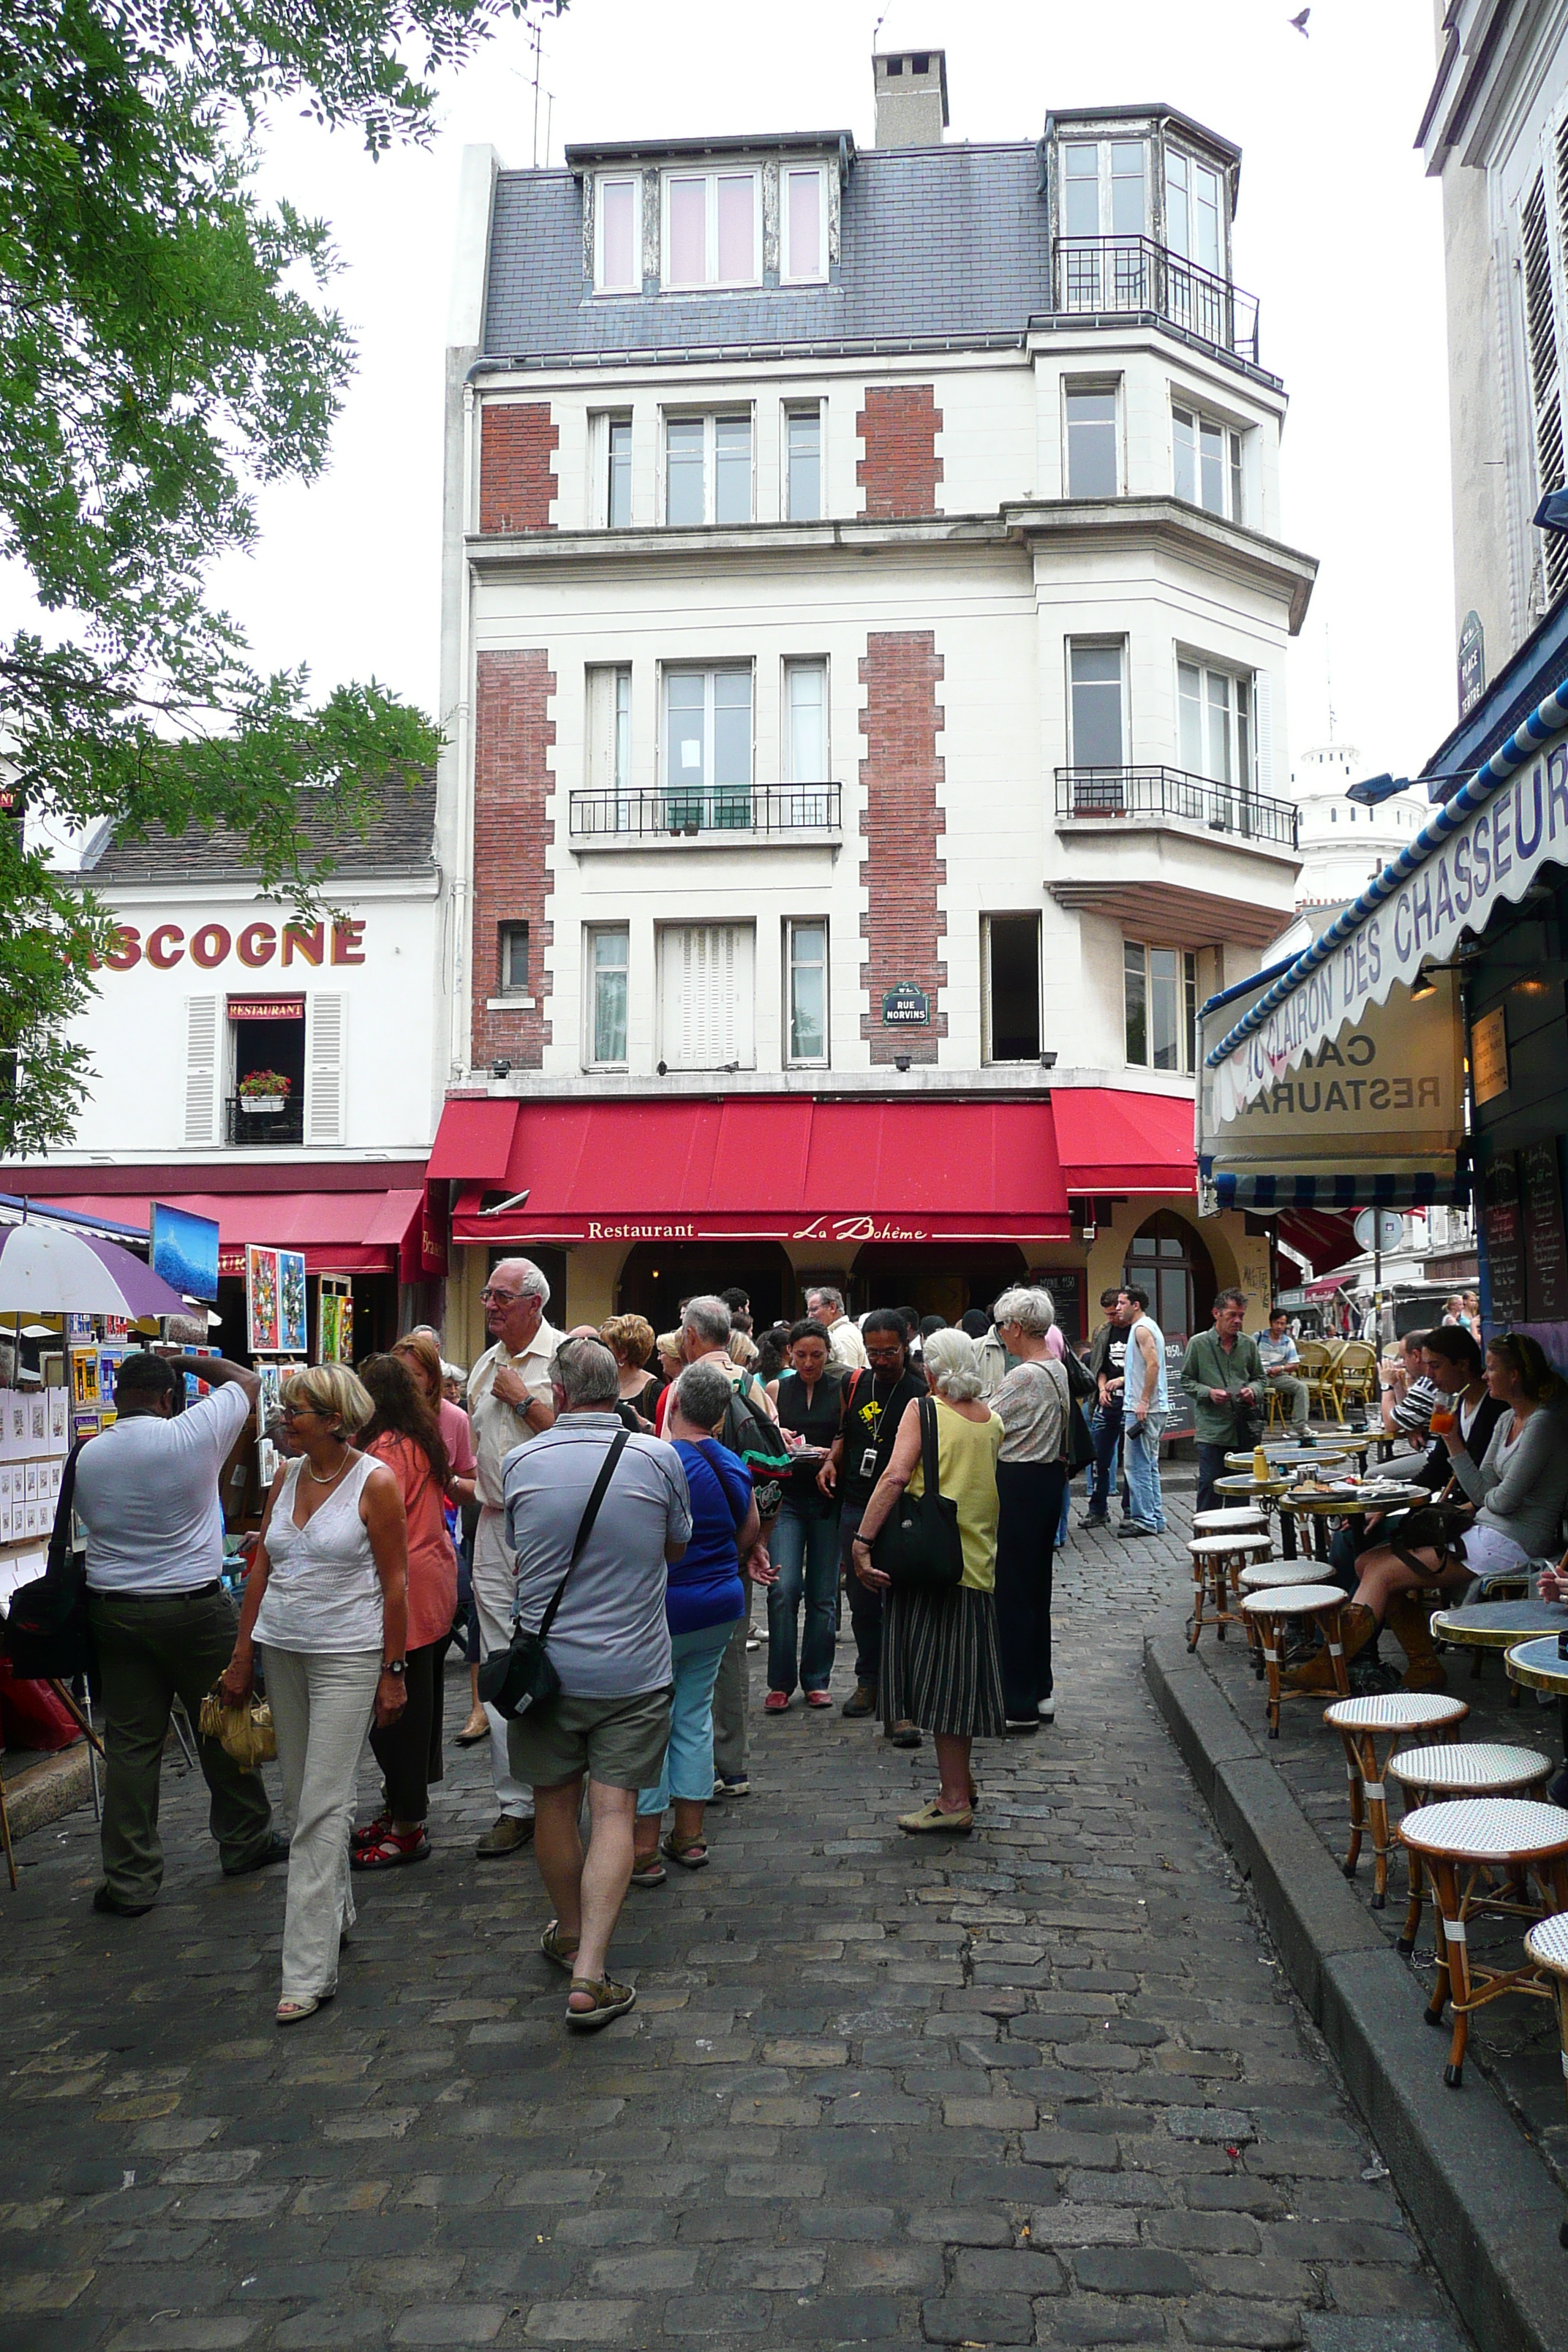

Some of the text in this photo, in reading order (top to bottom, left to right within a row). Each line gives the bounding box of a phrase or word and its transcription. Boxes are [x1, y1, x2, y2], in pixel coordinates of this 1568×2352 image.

[1462, 649, 1478, 681] PLACE
[1462, 682, 1481, 715] TERTRE
[1267, 963, 1333, 1067] CLAIRON
[1343, 918, 1382, 1007] DES
[1394, 742, 1568, 963] CHASSEUR
[228, 1004, 302, 1017] RESTAURANT
[886, 1011, 926, 1019] NORVINS
[897, 1000, 916, 1009] RUE
[587, 1215, 927, 1240] Restaurant La Bohème
